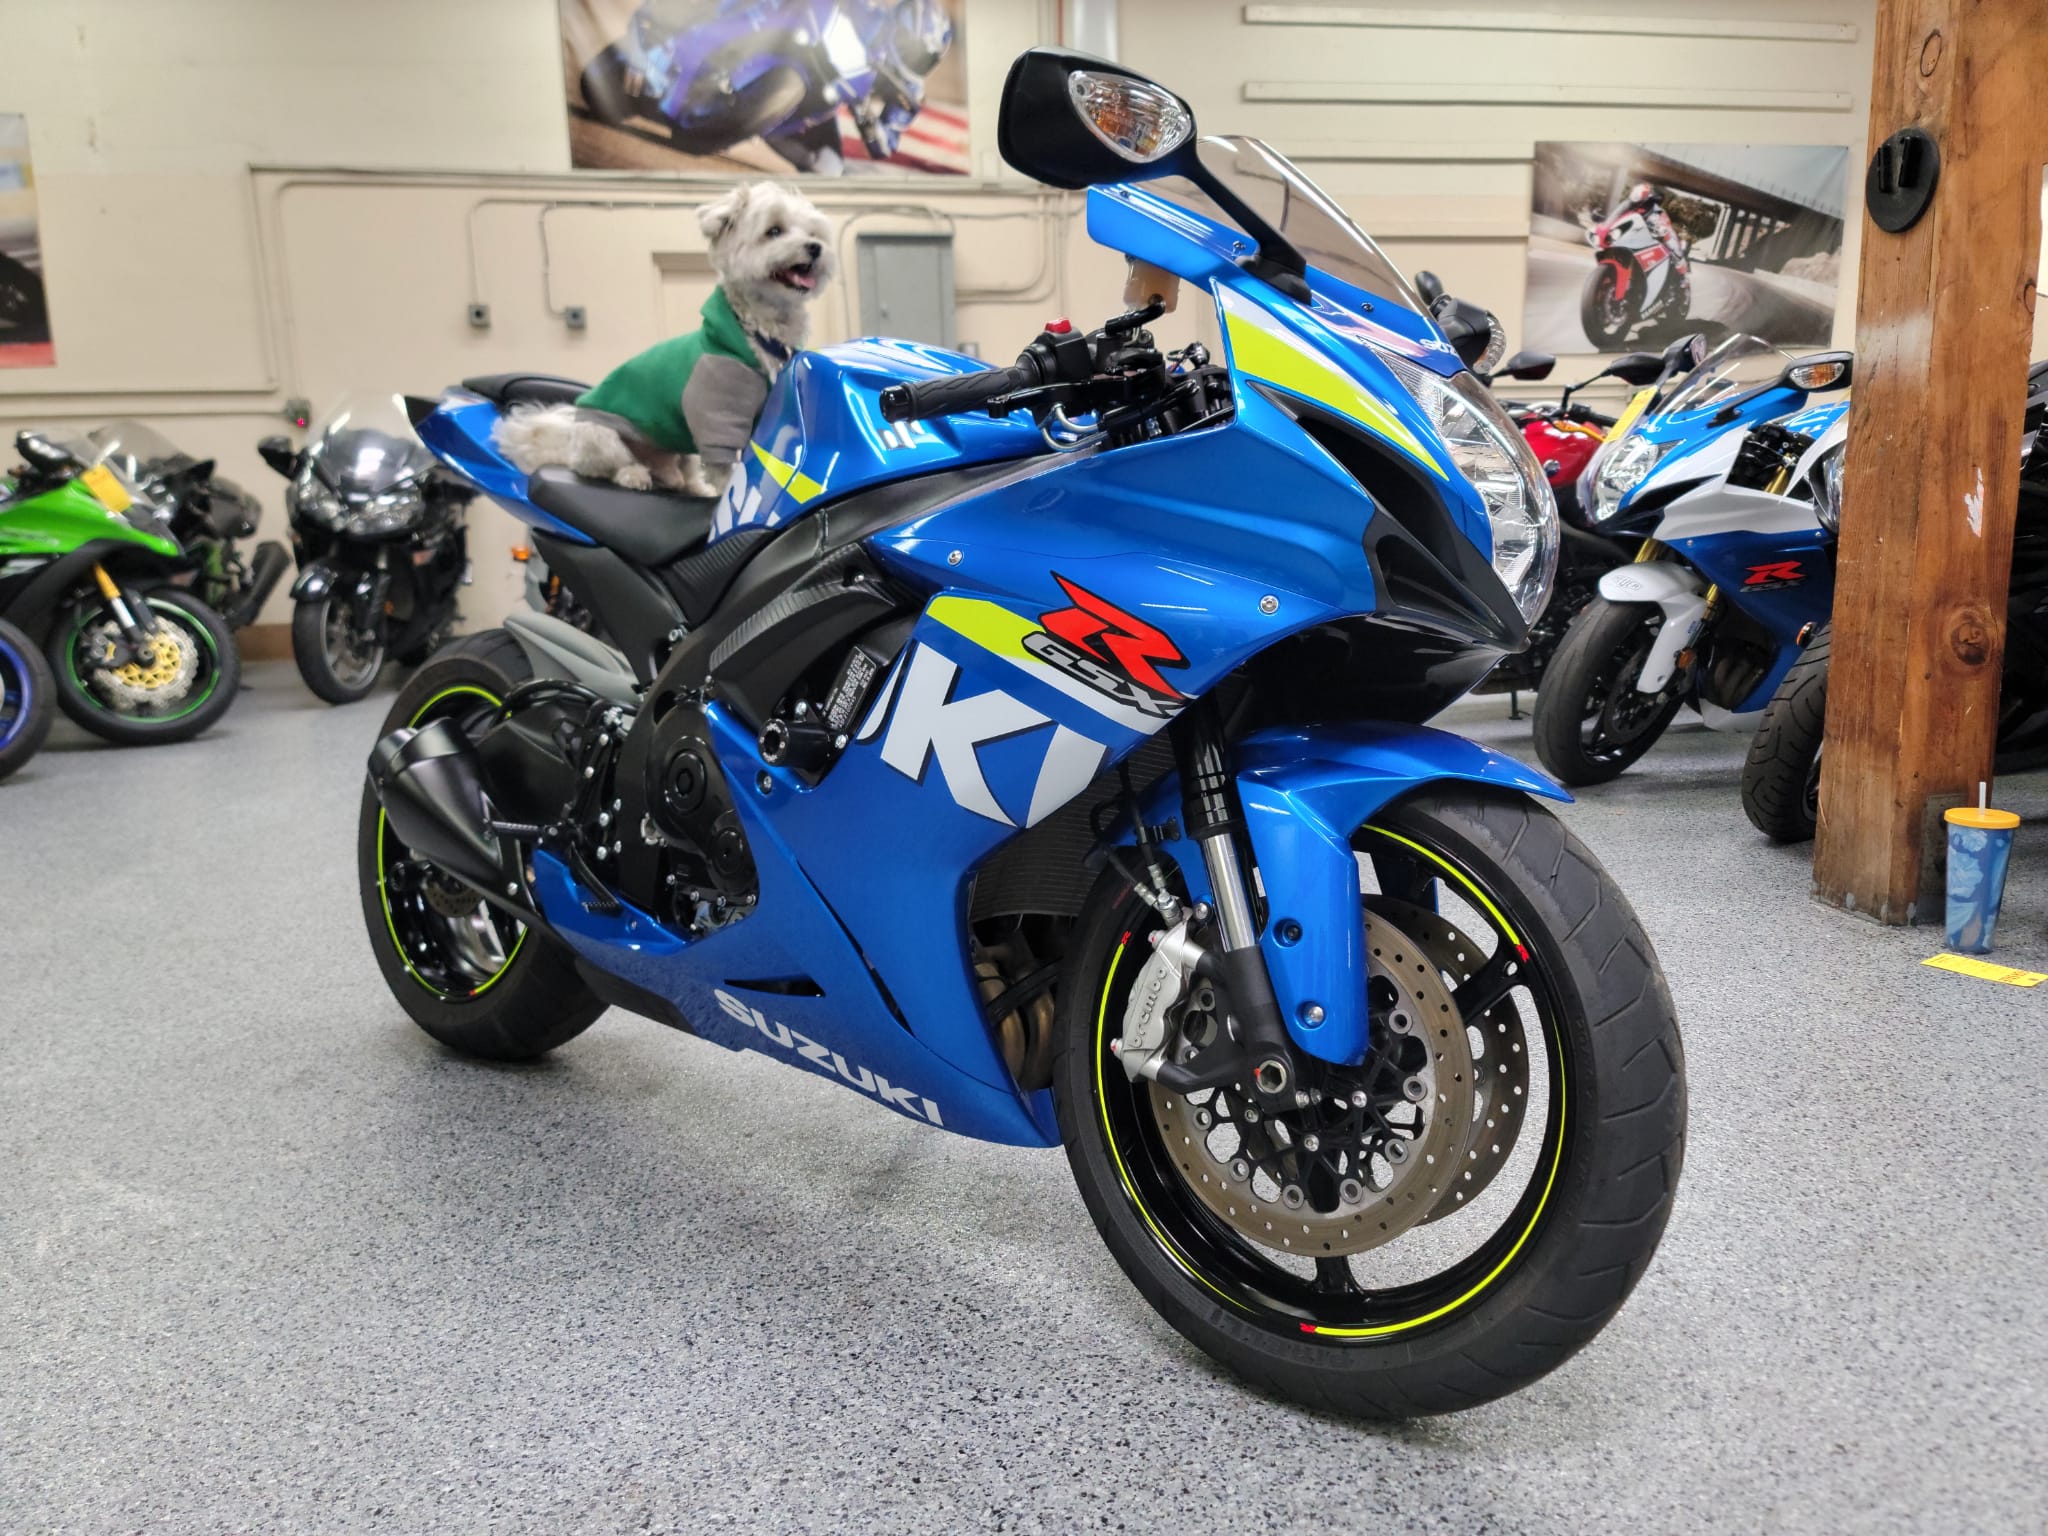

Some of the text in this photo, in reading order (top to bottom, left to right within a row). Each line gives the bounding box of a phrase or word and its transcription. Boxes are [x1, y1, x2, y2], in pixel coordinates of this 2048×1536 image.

[1038, 570, 1190, 701] R
[713, 988, 944, 1127] SUZUKI
[1127, 966, 1168, 1050] brembo
